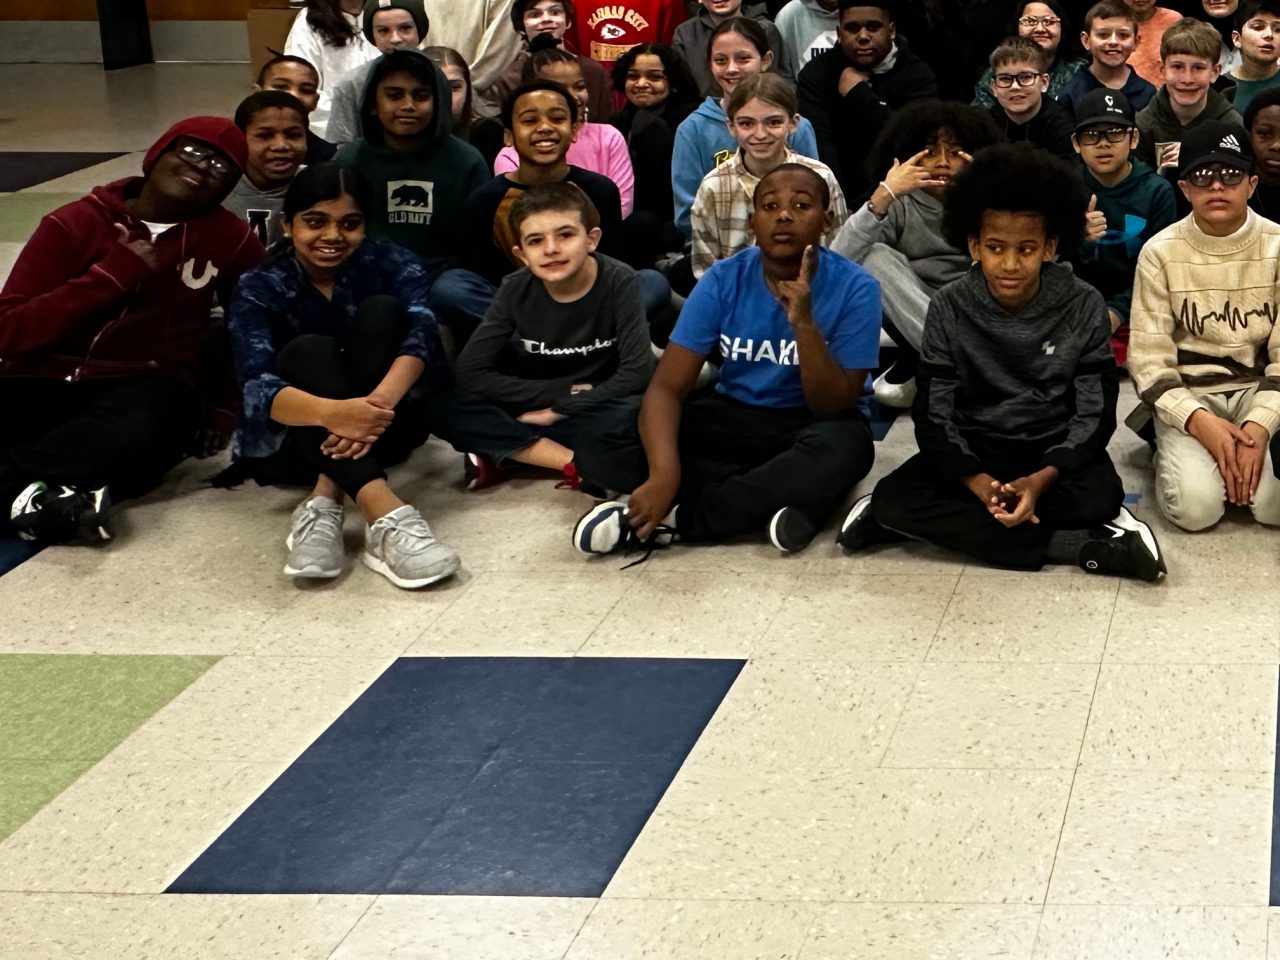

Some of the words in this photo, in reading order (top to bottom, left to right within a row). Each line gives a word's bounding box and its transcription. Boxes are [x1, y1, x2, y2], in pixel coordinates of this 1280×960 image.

[388, 211, 407, 224] OLD
[408, 212, 432, 225] NAVY
[719, 333, 800, 365] SHAK
